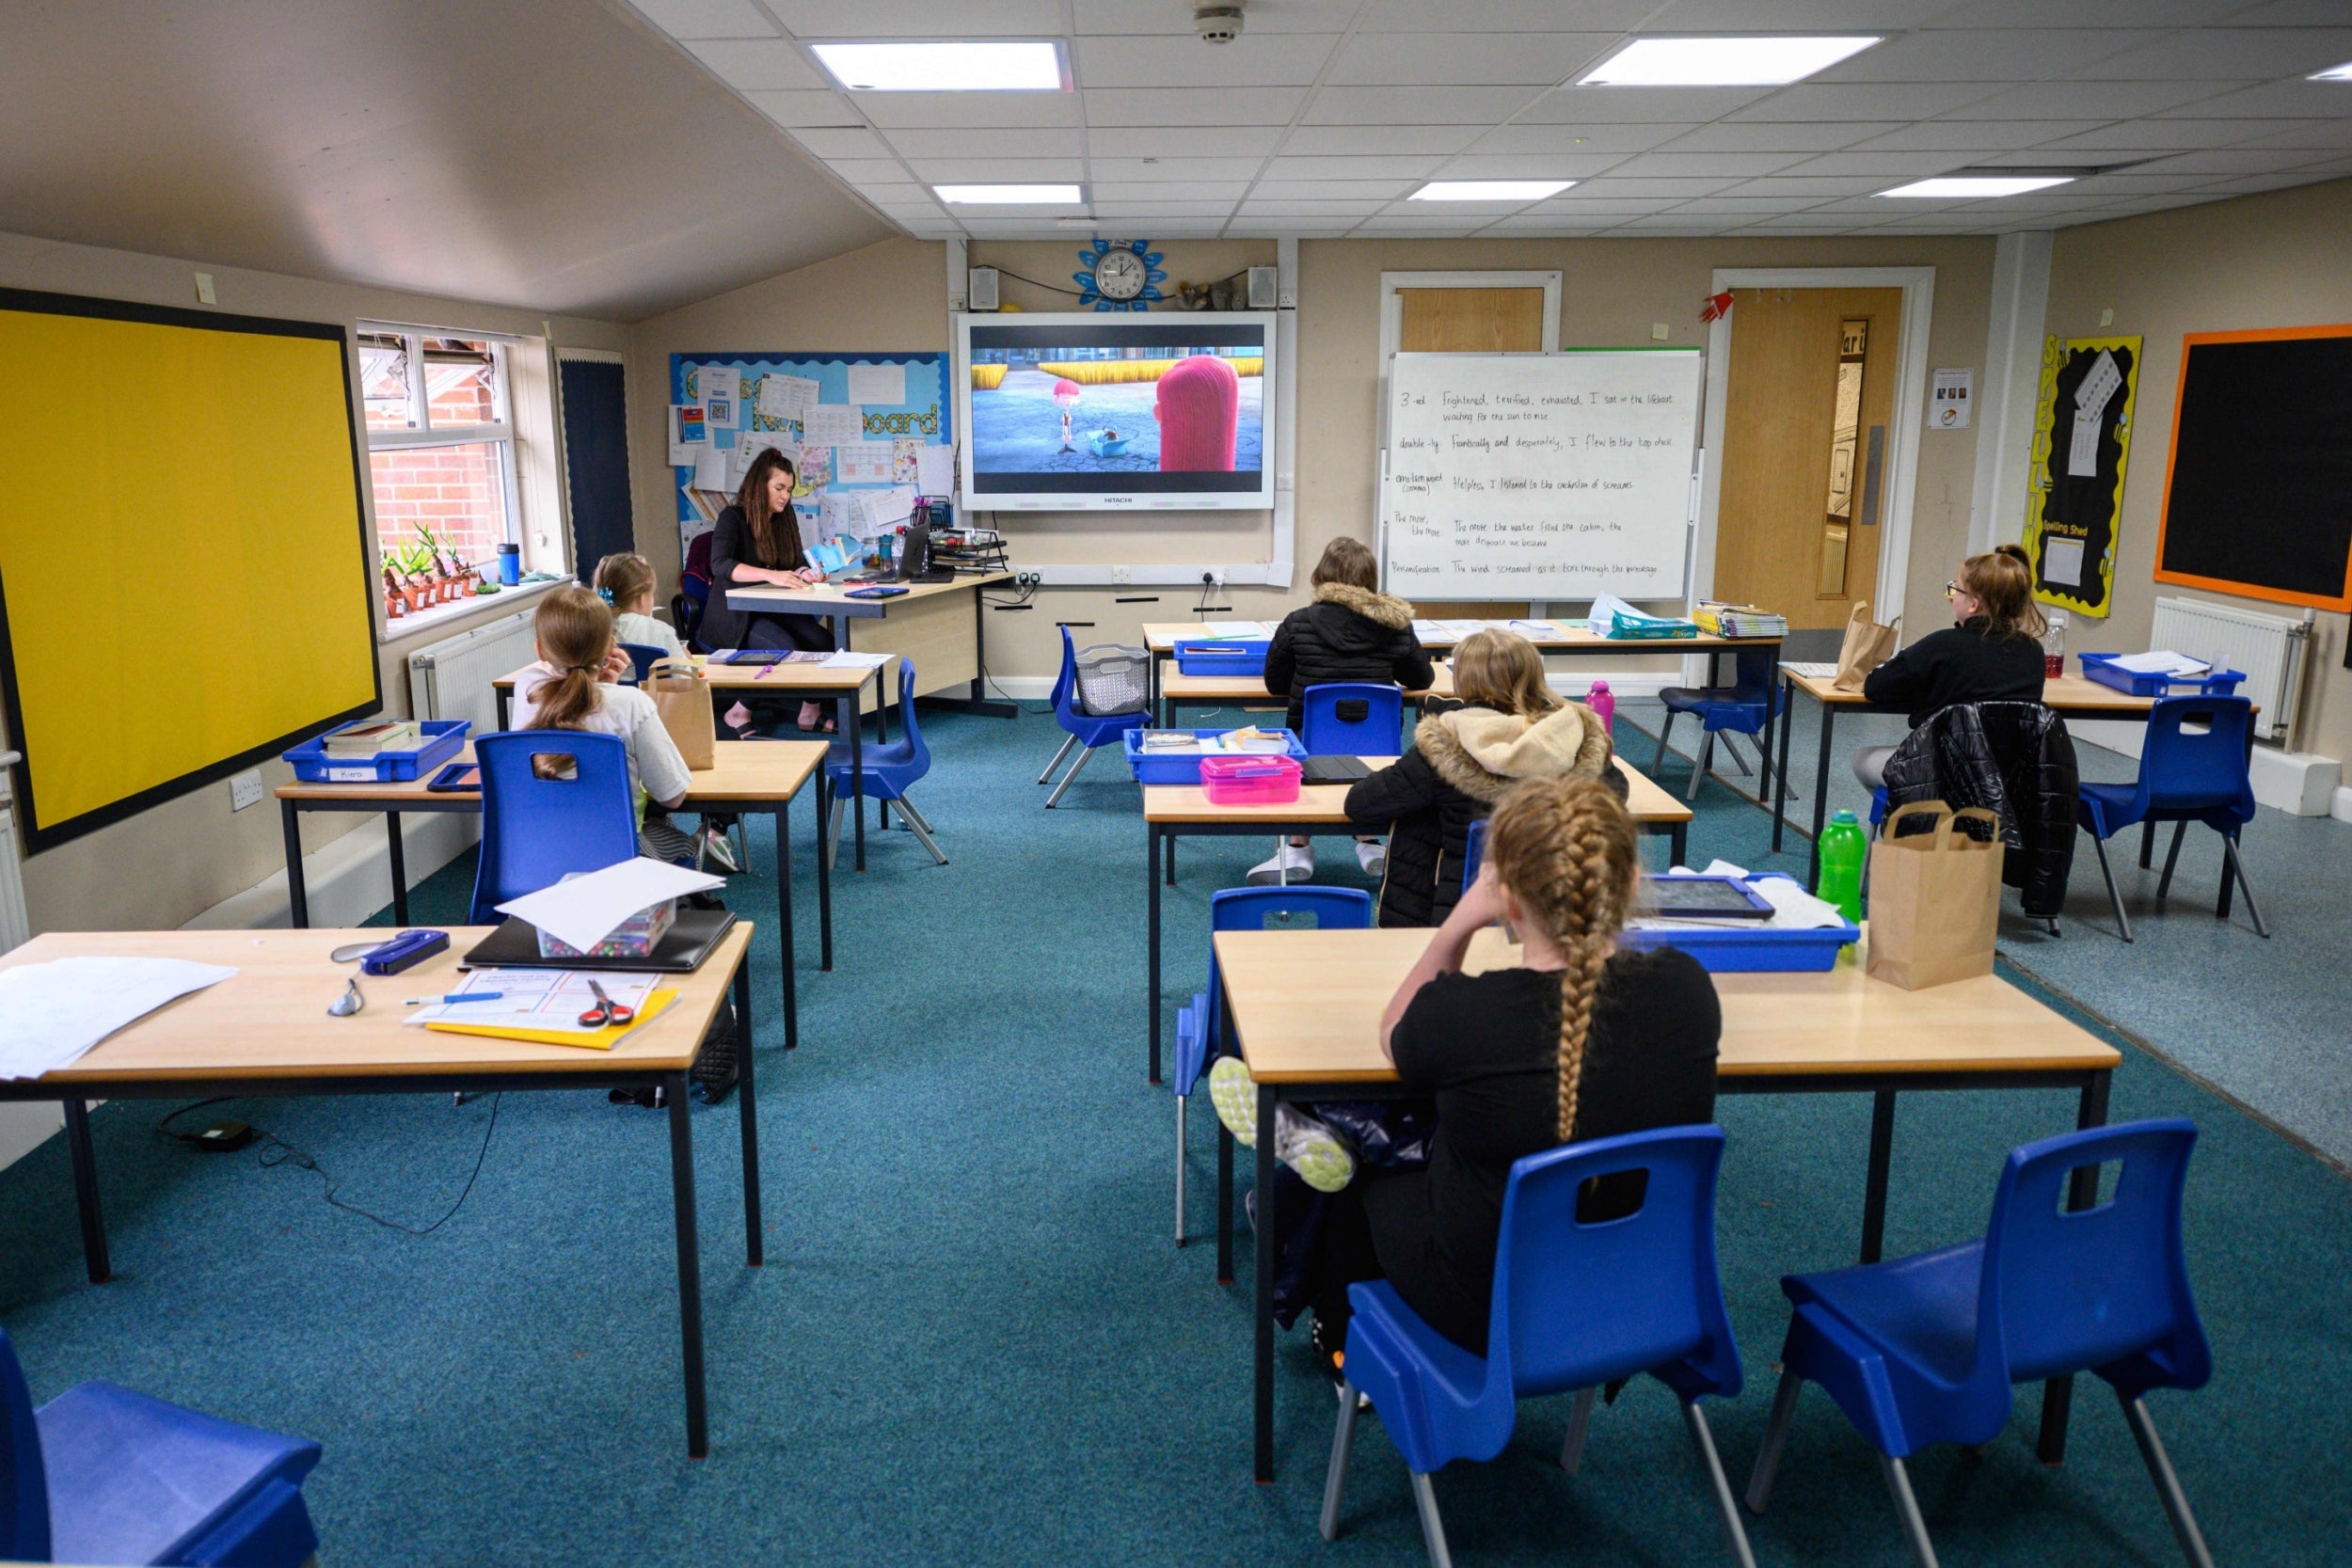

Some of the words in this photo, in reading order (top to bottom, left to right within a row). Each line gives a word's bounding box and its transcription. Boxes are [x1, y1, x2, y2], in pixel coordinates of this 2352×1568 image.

[1401, 392, 1410, 406] 3
[1589, 391, 1599, 404] I
[1604, 394, 1616, 404] sat
[1630, 393, 1643, 404] the
[1442, 412, 1473, 424] waiting
[1491, 412, 1503, 420] the
[1522, 412, 1532, 420] to
[1399, 437, 1424, 449] double
[1494, 436, 1509, 448] and
[1568, 436, 1578, 447] I
[1609, 437, 1617, 448] to
[1619, 436, 1633, 448] the
[1638, 437, 1652, 450] top
[1489, 479, 1498, 488] I
[1530, 479, 1537, 489] to
[1540, 479, 1553, 489] the
[1591, 478, 1600, 489] of
[1393, 511, 1406, 523] The
[1412, 525, 1424, 536] the
[1454, 519, 1467, 532] The
[1470, 522, 1487, 531] more
[1494, 522, 1506, 531] the
[1511, 521, 1534, 531] water
[1562, 522, 1574, 531] the
[1610, 521, 1622, 531] the
[2043, 519, 2069, 534] Spelling
[2070, 524, 2089, 536] Shed
[1450, 560, 1466, 573] The
[1470, 563, 1490, 573] wind
[1537, 564, 1547, 574] as
[1549, 563, 1556, 573] it
[1581, 563, 1610, 578] through
[1612, 563, 1623, 573] the
